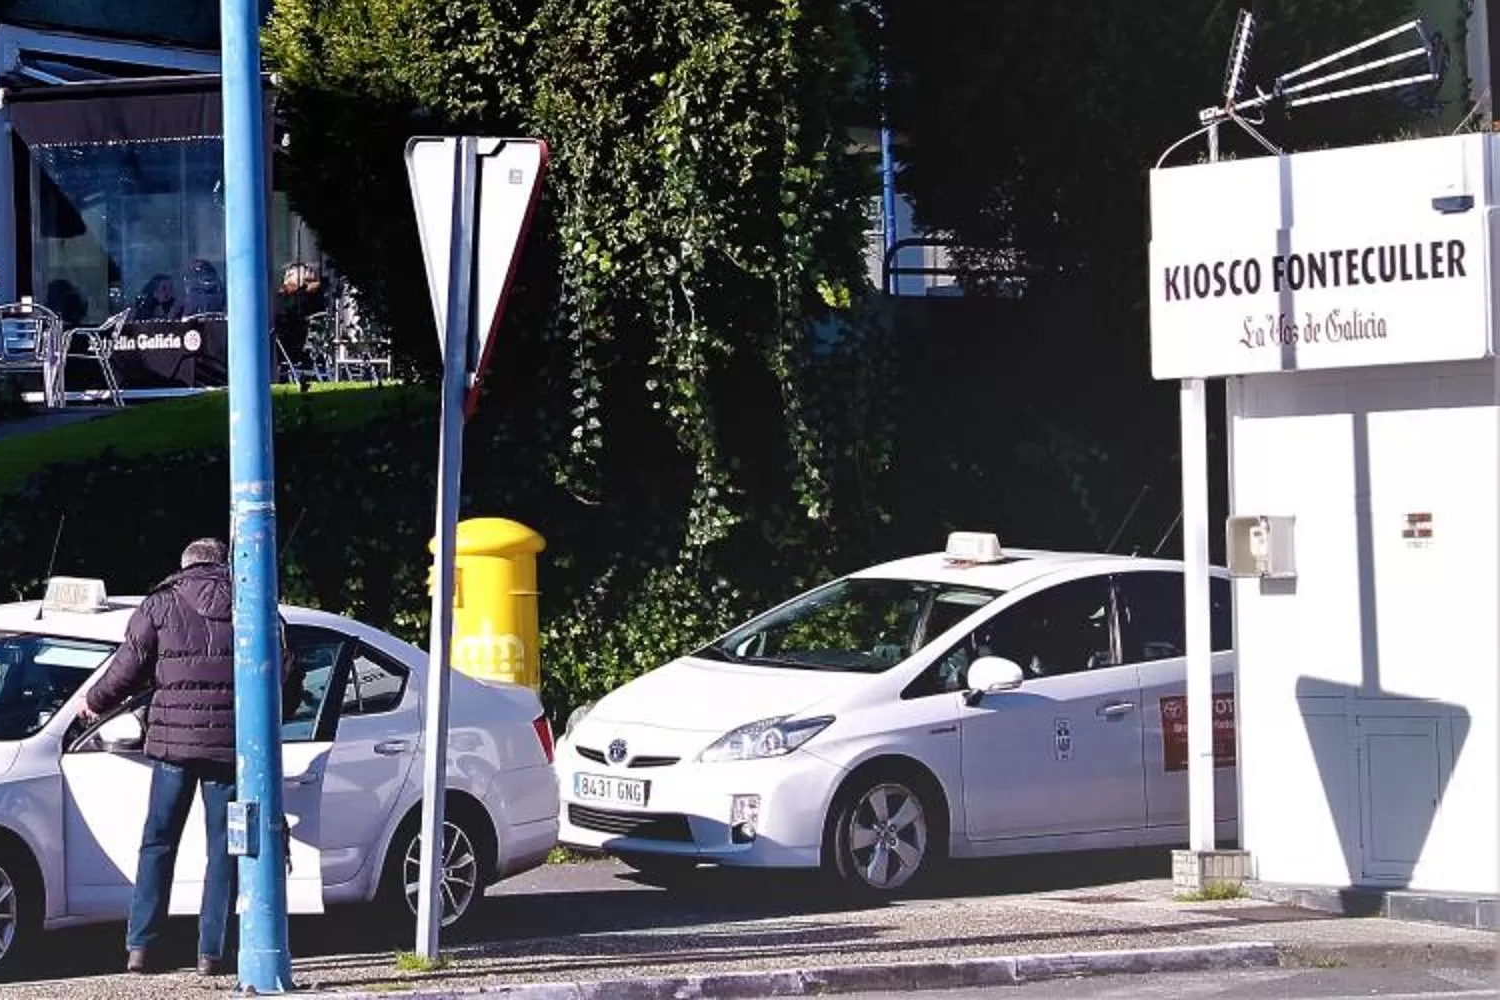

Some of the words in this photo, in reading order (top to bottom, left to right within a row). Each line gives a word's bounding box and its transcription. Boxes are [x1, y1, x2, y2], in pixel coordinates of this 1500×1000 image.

[1164, 258, 1261, 302] KIOSCO
[1272, 239, 1467, 292] FONTECULLER
[1303, 311, 1322, 344] de
[1325, 308, 1388, 342] Galicia
[581, 777, 611, 798] 8431
[617, 781, 642, 803] GNG
